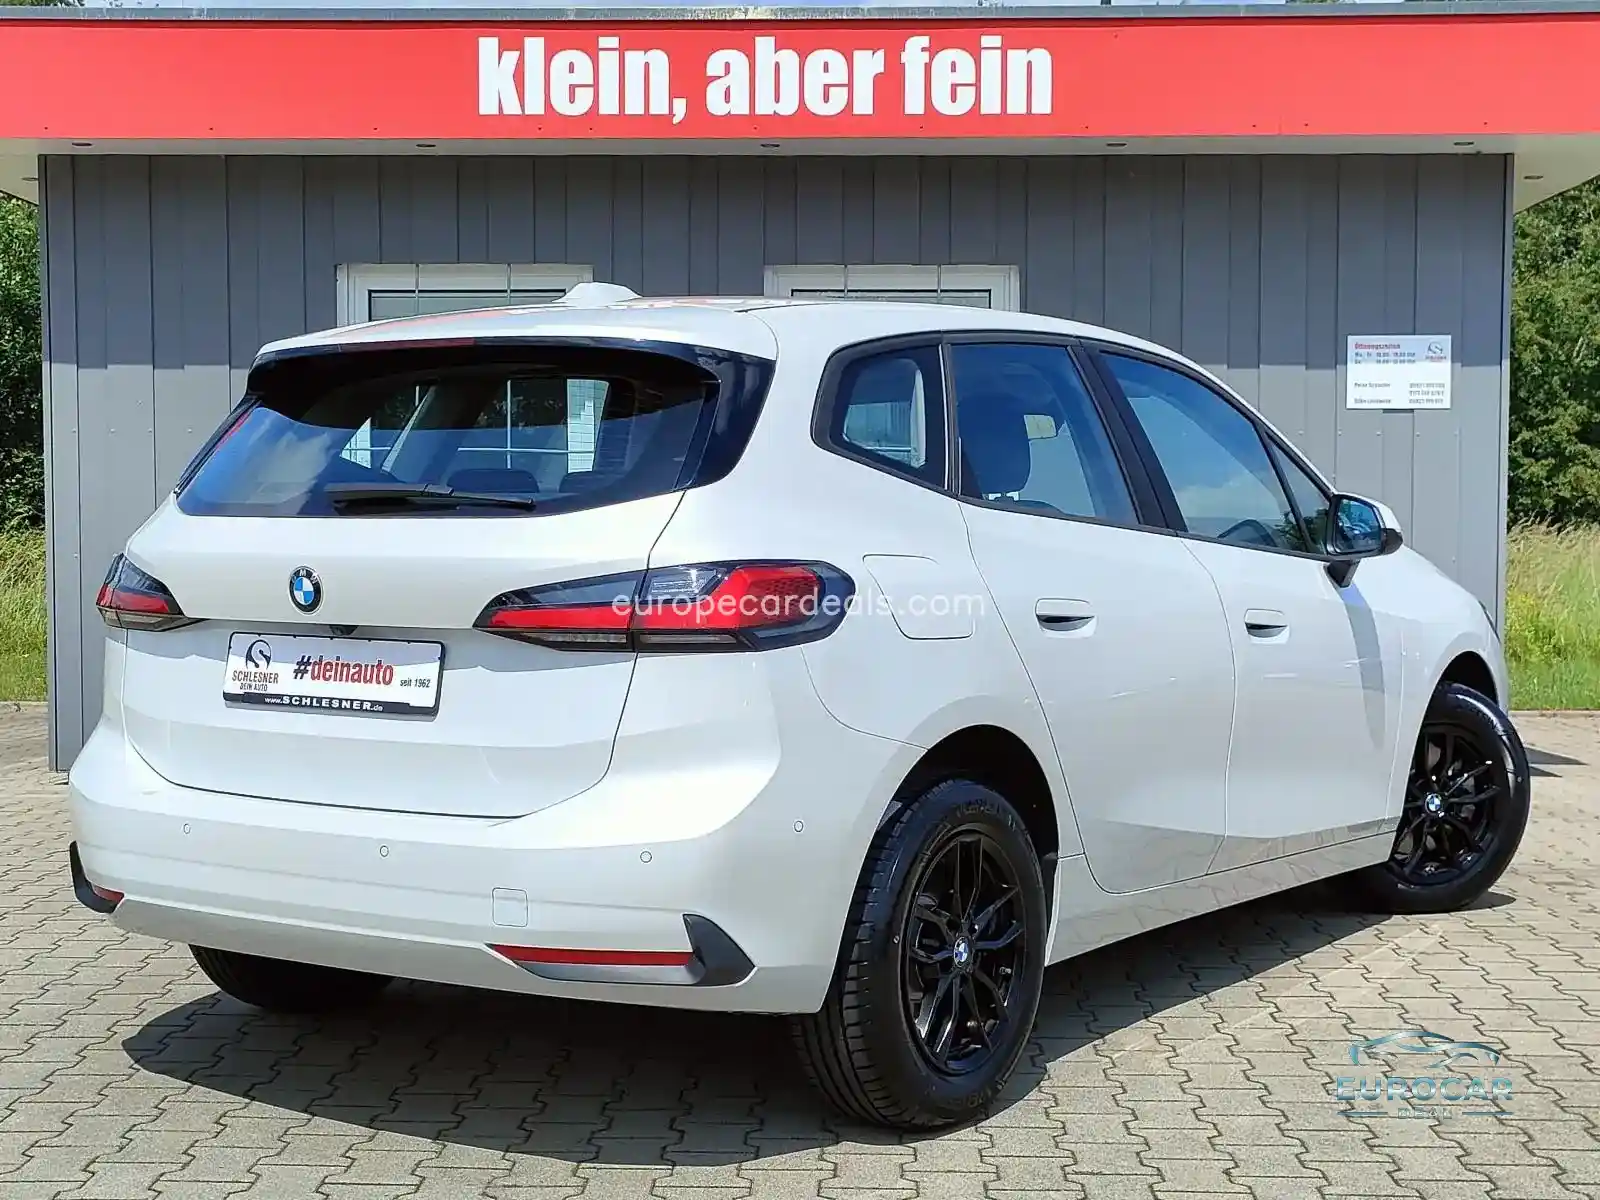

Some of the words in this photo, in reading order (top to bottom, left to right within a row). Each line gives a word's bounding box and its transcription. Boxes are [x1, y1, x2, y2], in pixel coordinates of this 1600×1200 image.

[477, 36, 689, 124] klein,
[705, 36, 885, 116] aber
[901, 34, 1053, 116] fein
[231, 669, 280, 684] SCHLESNER
[292, 655, 394, 686] #deinauto
[239, 682, 253, 691] DEIN
[253, 683, 268, 692] AUTO
[400, 677, 412, 688] seit
[414, 678, 431, 689] 1962
[264, 694, 383, 712] www.SCHLESNER.de
